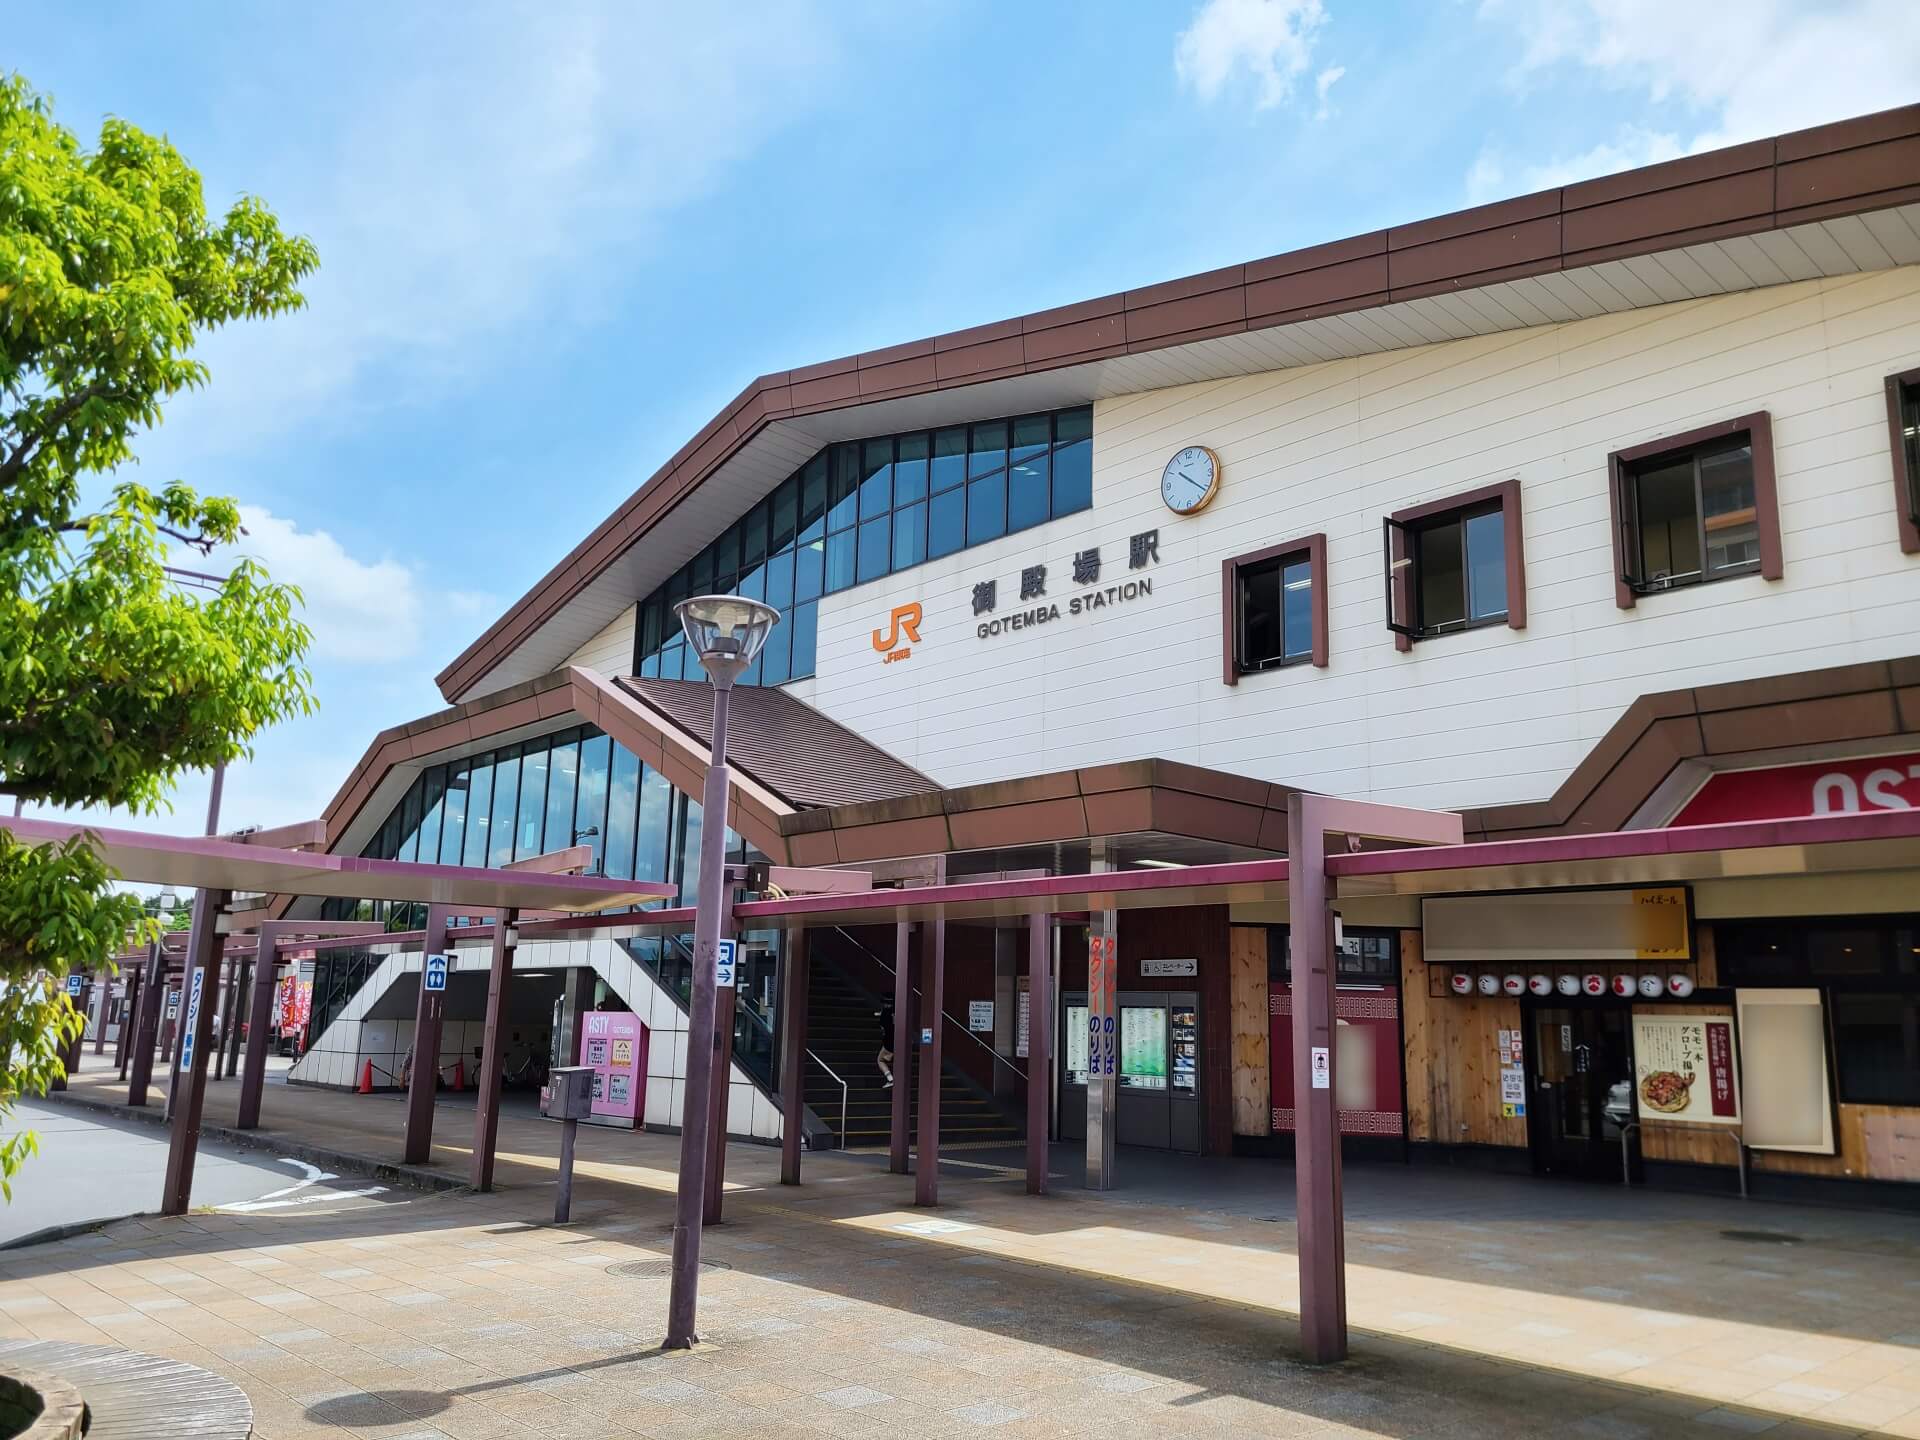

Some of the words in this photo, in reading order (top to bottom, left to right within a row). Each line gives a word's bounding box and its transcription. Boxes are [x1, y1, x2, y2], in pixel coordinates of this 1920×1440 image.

[1185, 450, 1193, 460] 12
[970, 528, 1160, 617] 御殿場駅
[872, 602, 922, 651] JR
[977, 602, 1060, 640] GOTEMBA
[1069, 577, 1153, 617] STATION
